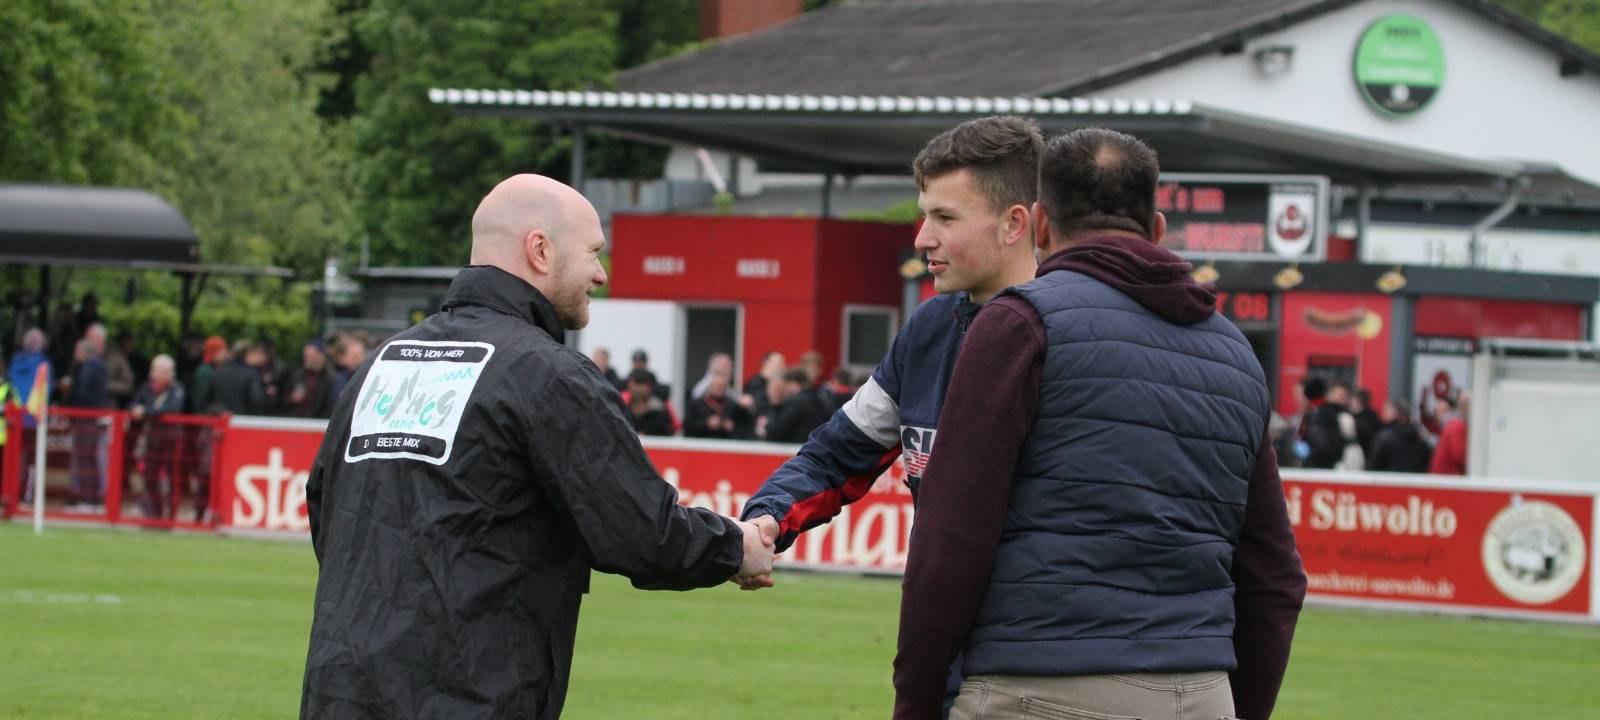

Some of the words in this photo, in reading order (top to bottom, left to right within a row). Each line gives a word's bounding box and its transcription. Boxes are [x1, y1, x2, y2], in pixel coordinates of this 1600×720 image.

[1233, 293, 1270, 320] 08
[400, 348, 423, 358] 100%
[424, 349, 443, 358] VON
[377, 437, 402, 447] BESTE
[402, 437, 421, 449] MIX
[1309, 488, 1457, 538] Süwolto
